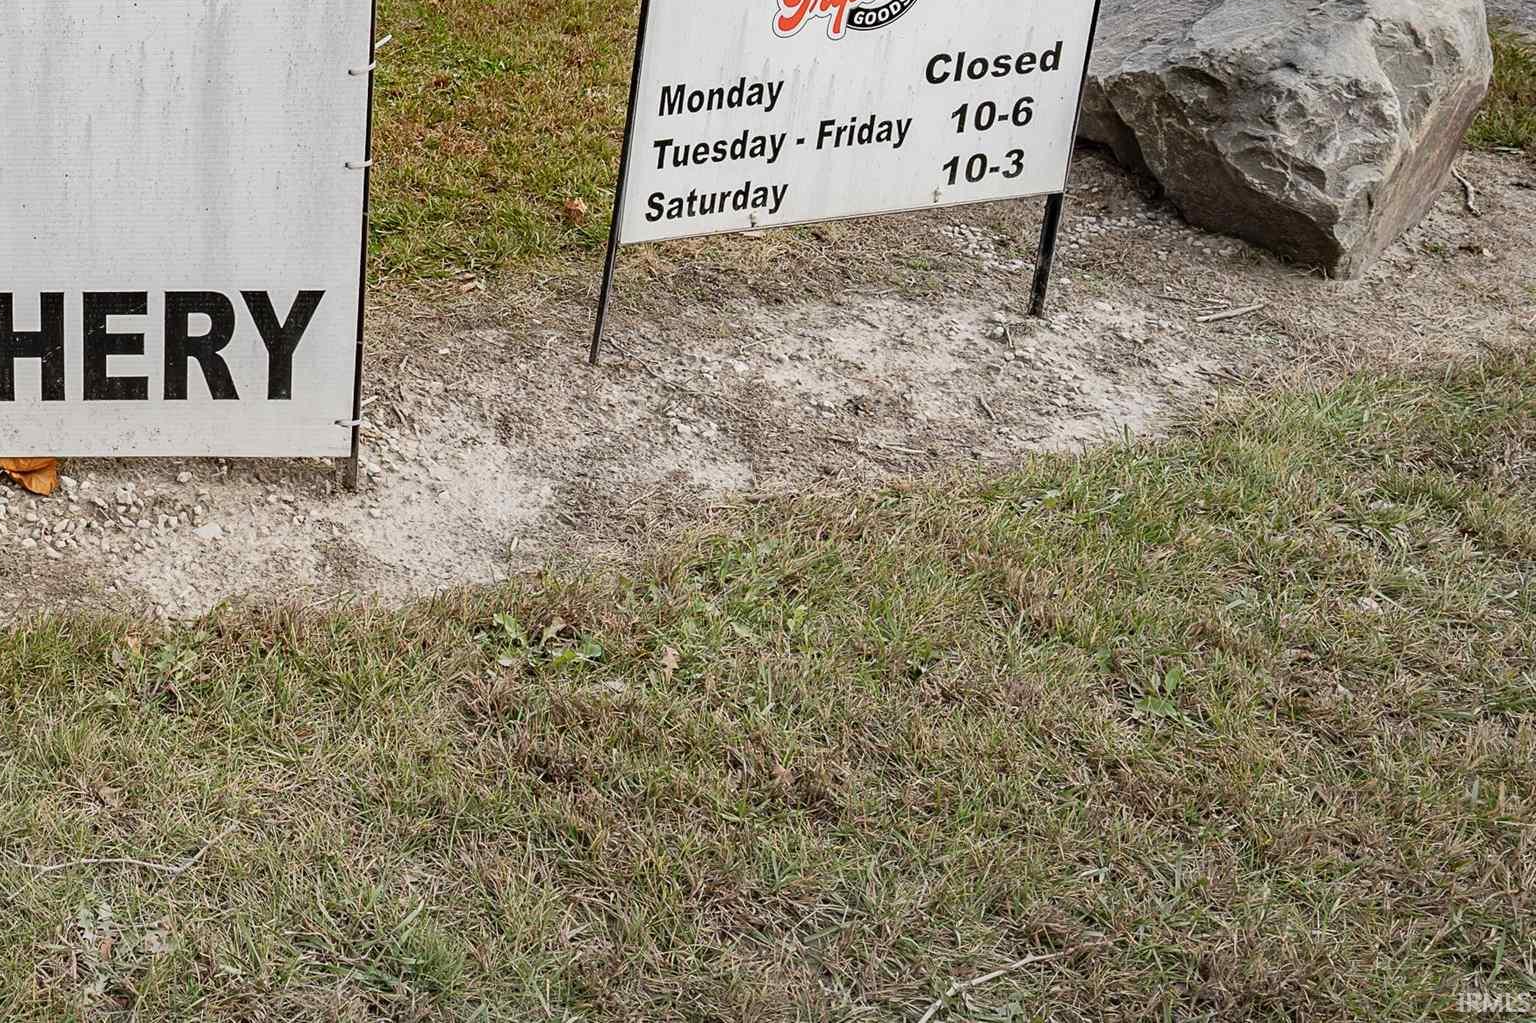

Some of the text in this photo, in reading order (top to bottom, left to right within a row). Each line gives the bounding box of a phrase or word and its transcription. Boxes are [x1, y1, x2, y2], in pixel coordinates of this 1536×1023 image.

[658, 40, 1064, 117] Monday Closed
[652, 129, 787, 170] Tuesday
[816, 114, 913, 150] Friday
[951, 96, 1034, 134] 10-6
[644, 148, 1025, 223] Saturday 10-3
